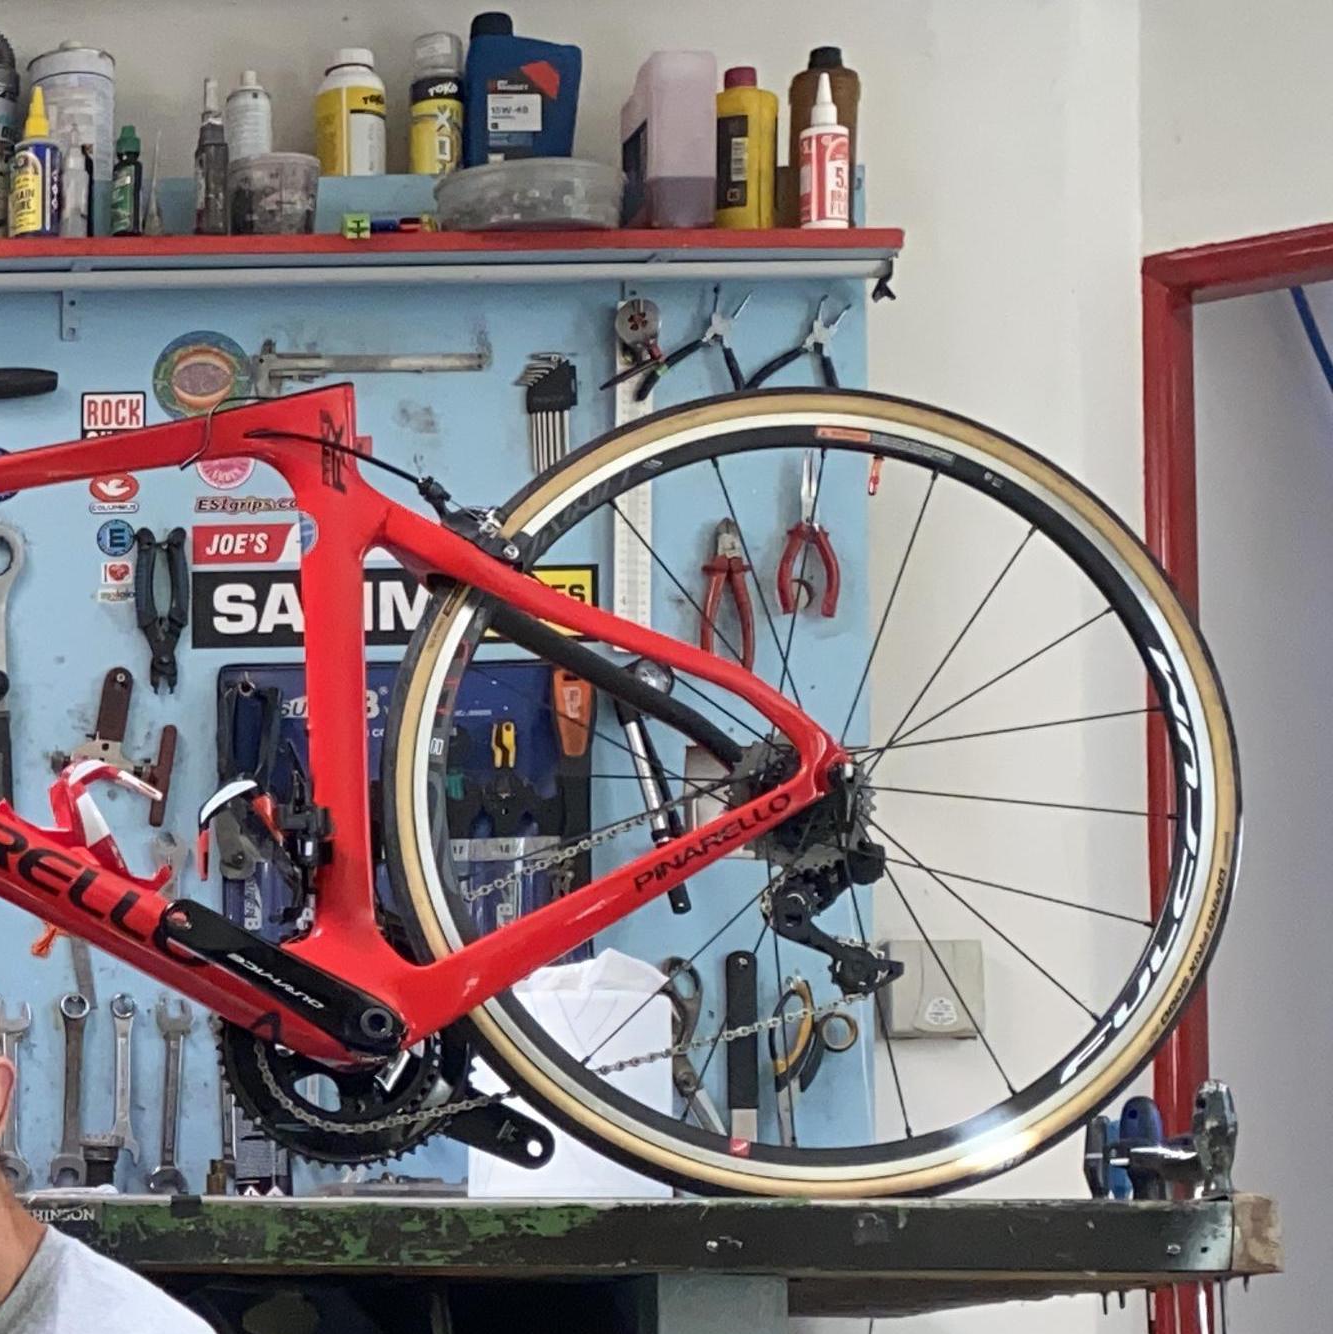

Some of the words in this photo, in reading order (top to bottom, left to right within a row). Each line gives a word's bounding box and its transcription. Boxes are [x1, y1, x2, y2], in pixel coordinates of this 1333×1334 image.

[87, 399, 141, 427] ROCK
[205, 533, 269, 555] JOE'S
[211, 581, 435, 635] SAIM
[634, 793, 792, 893] PINARELLO
